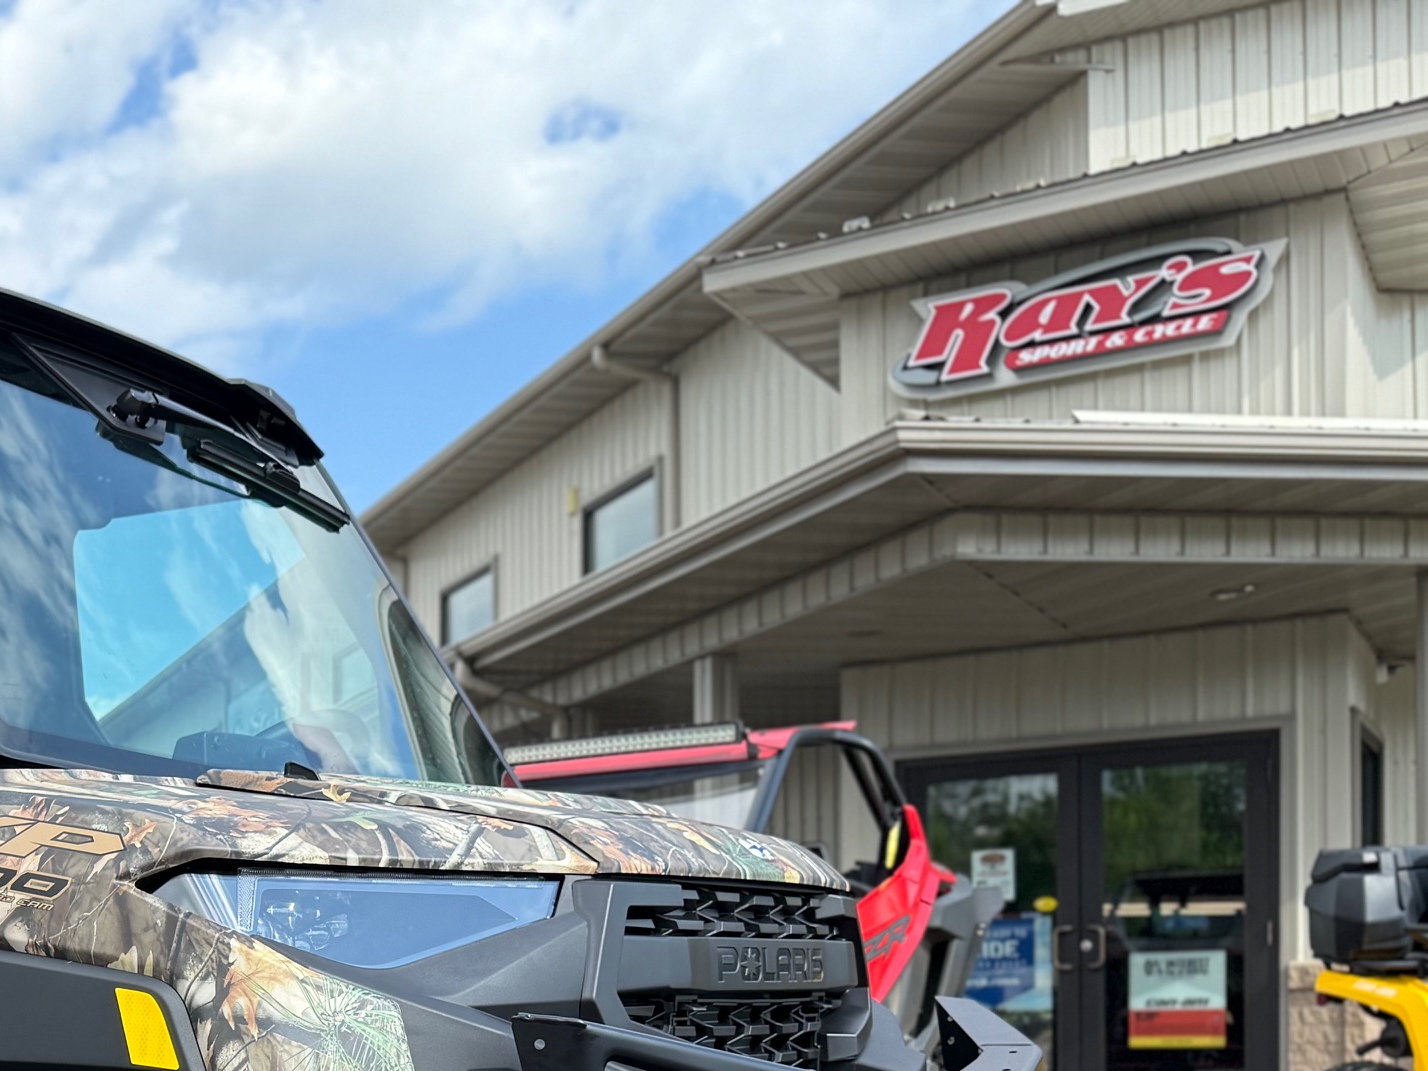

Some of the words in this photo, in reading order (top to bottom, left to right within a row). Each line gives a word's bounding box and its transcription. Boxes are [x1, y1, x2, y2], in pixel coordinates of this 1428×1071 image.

[1015, 335, 1103, 366] SPORT
[1105, 331, 1126, 348] &
[1133, 313, 1215, 343] CYCLE
[16, 899, 55, 912] CAM
[716, 946, 824, 984] POLARIS
